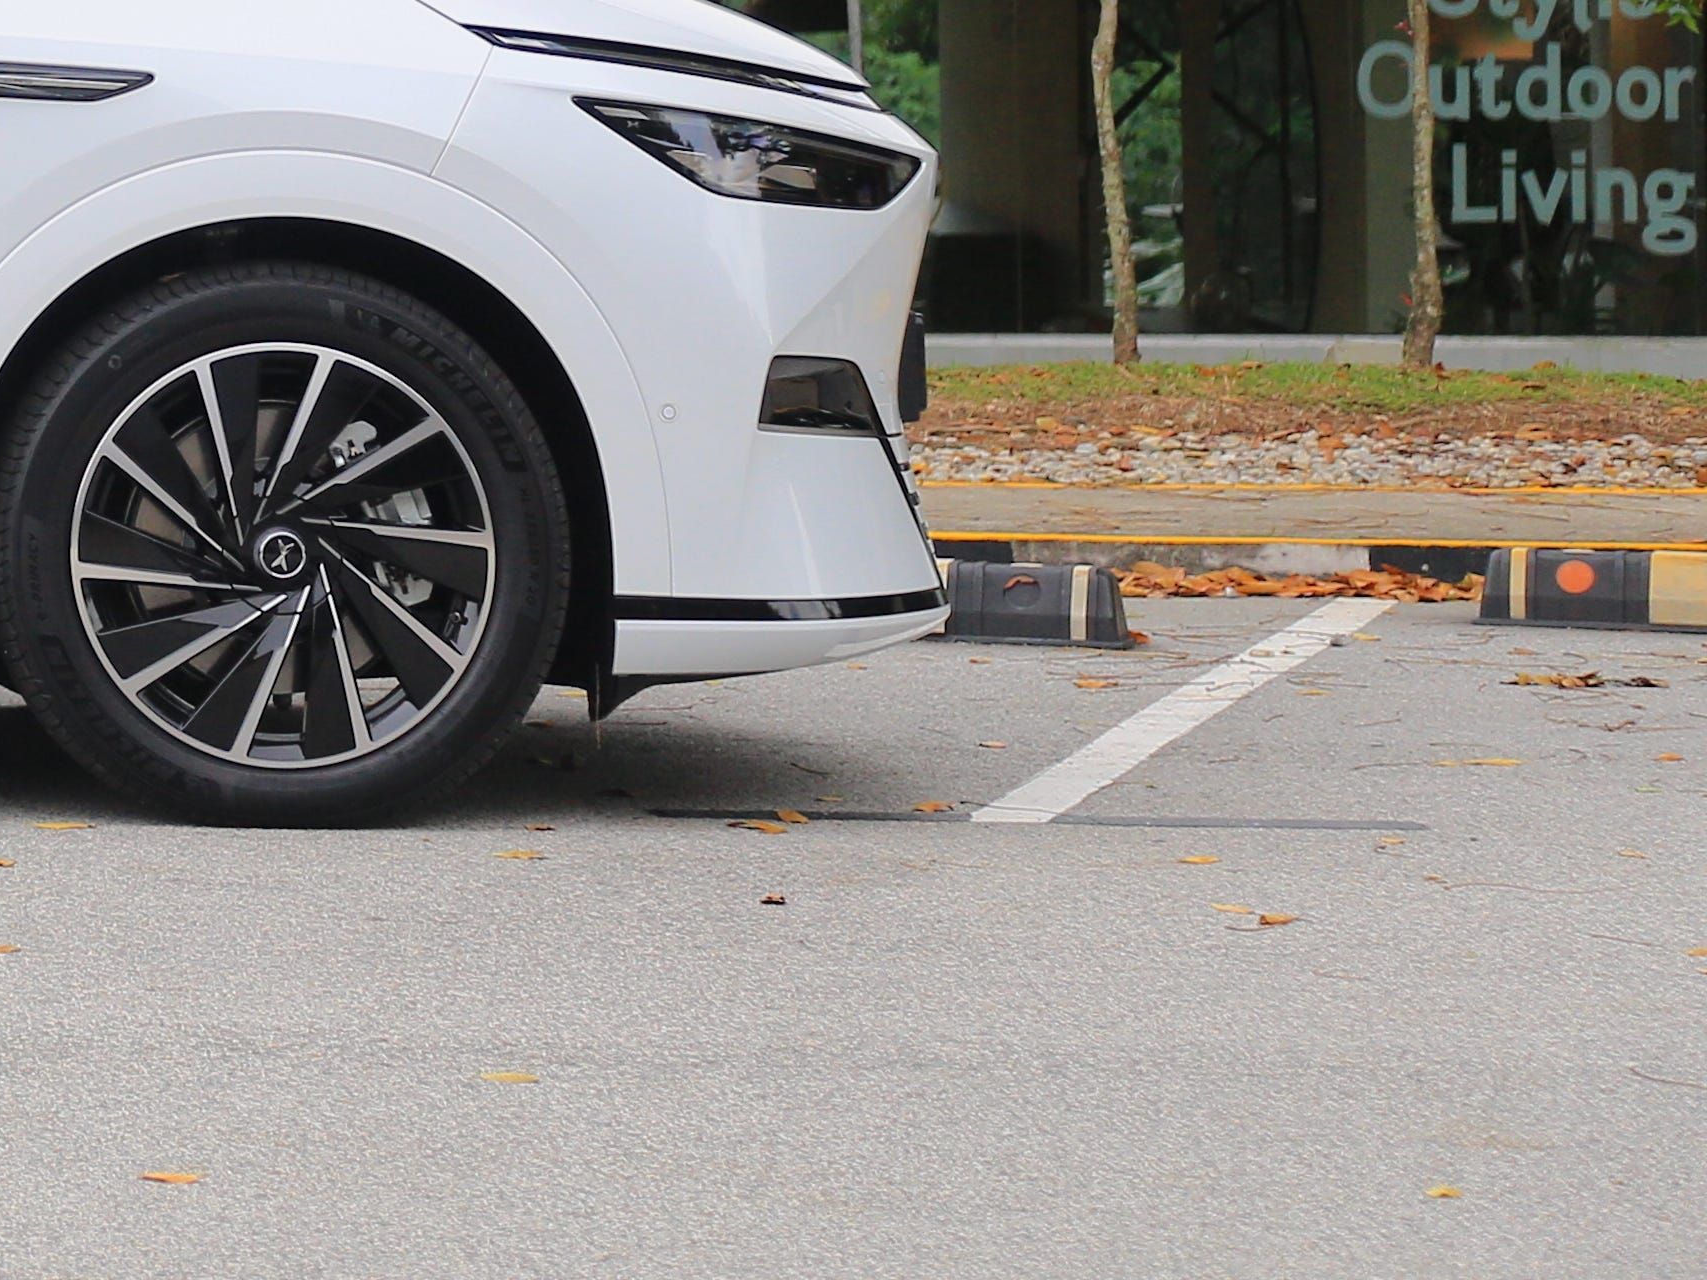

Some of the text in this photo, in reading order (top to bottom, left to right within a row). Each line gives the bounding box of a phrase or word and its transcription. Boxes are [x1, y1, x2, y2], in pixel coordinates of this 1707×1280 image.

[1356, 40, 1697, 123] Outdoor
[1451, 143, 1698, 257] Living
[390, 326, 524, 465] MICHELIN
